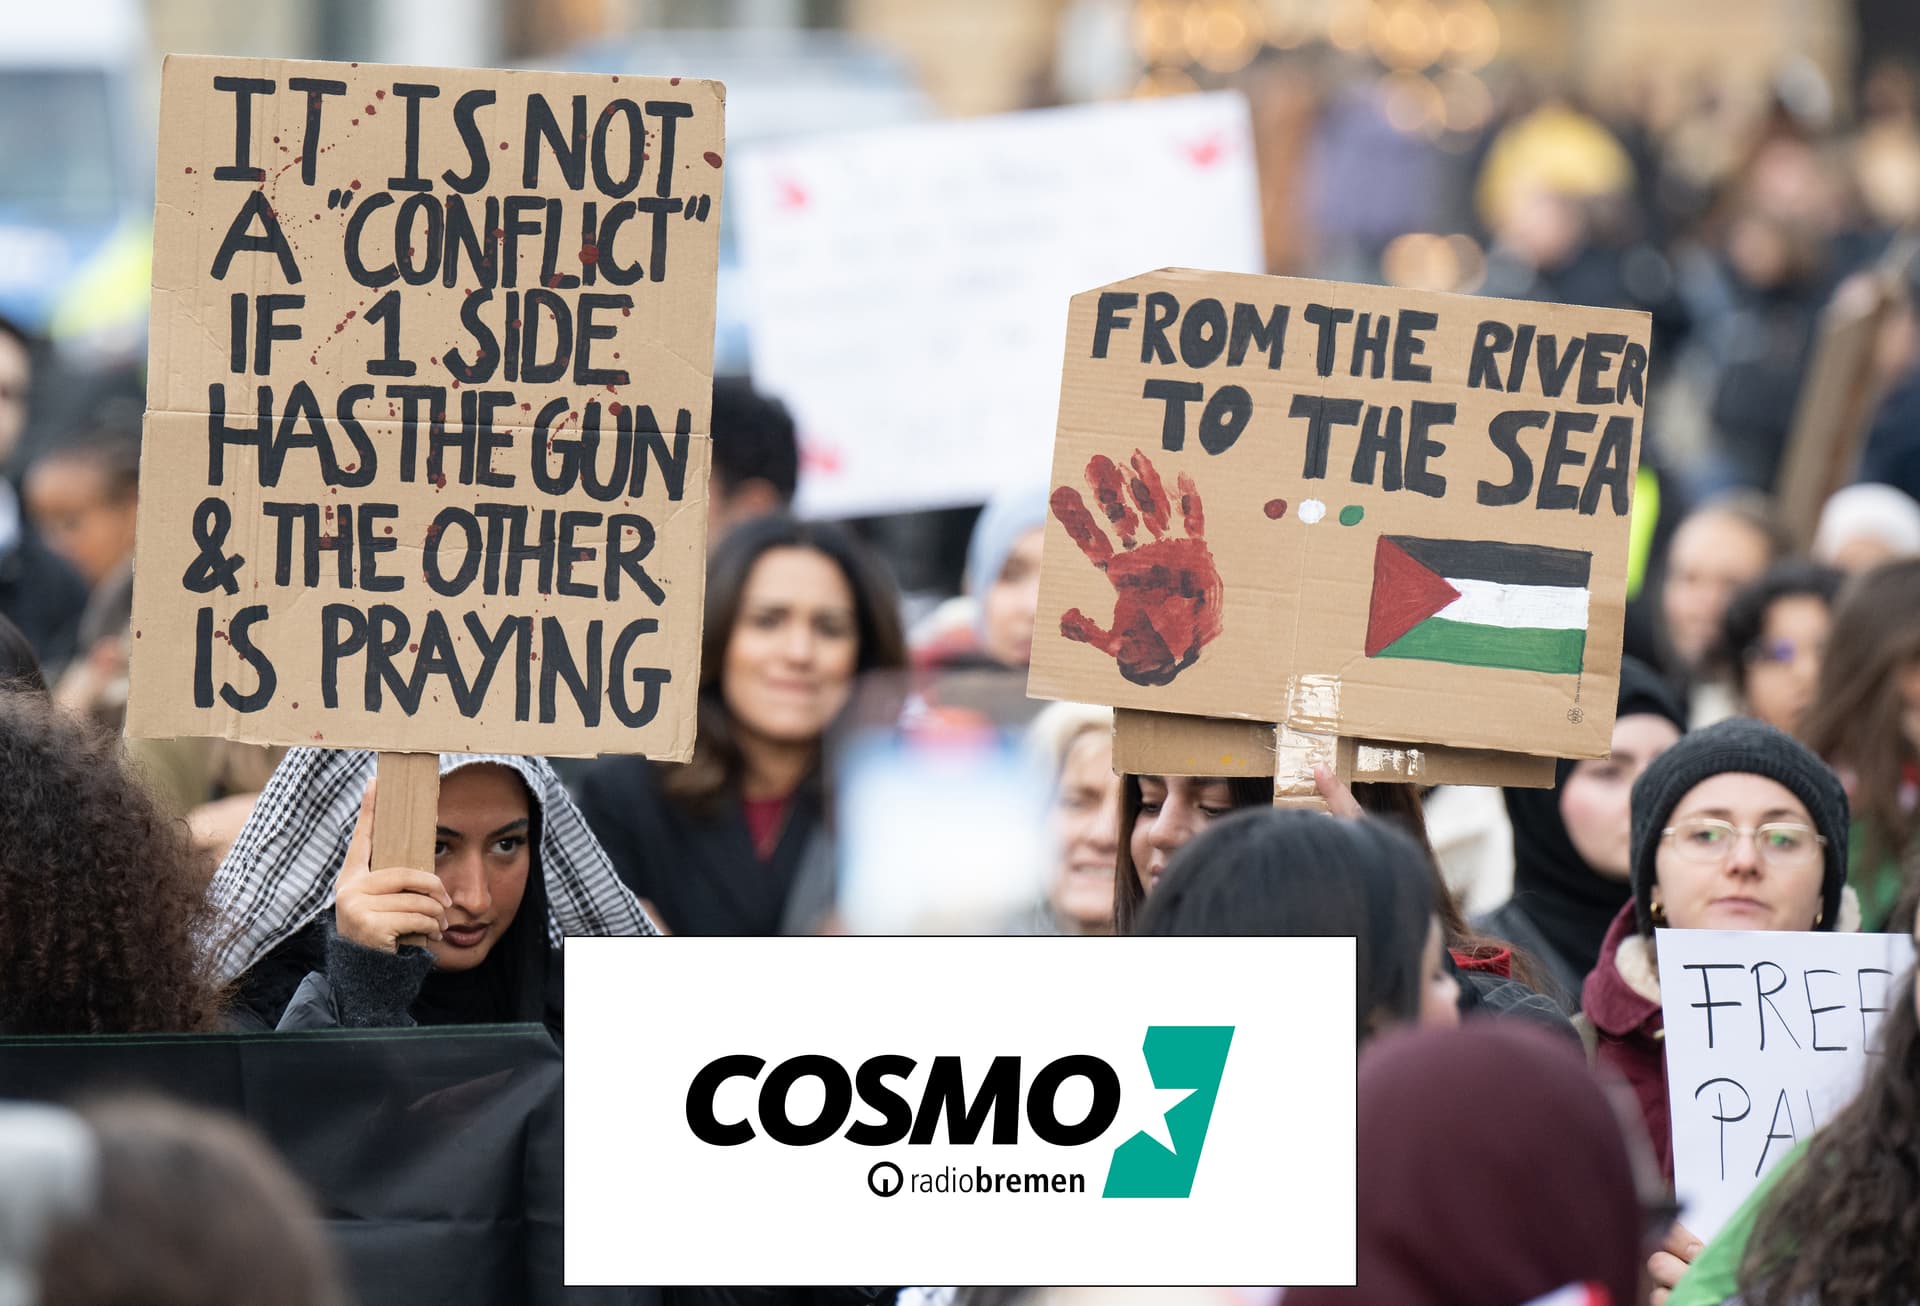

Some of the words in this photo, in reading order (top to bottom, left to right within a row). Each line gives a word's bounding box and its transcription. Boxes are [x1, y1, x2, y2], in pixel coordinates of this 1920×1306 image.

[213, 76, 346, 185] IT
[388, 83, 496, 194] IS
[522, 94, 693, 199] NOT
[211, 191, 302, 284] A
[327, 189, 710, 288] "CONFLICT"
[230, 293, 305, 375] IF
[364, 290, 416, 376] 1
[442, 288, 633, 385] SIDE
[1090, 291, 1290, 370] FROM
[1304, 303, 1438, 383] THE
[1467, 320, 1648, 407] RIVER
[208, 381, 377, 488] HAS
[386, 385, 516, 488] THE
[531, 397, 691, 501] GUN
[1143, 379, 1254, 455] TO
[1289, 394, 1456, 498] THE
[1476, 410, 1634, 516] SEA
[183, 498, 245, 595] &
[263, 502, 404, 592] THE
[422, 503, 665, 605] OTHER
[194, 605, 276, 713] IS
[321, 603, 671, 728] PRAYING
[1683, 961, 1893, 1056] FREE
